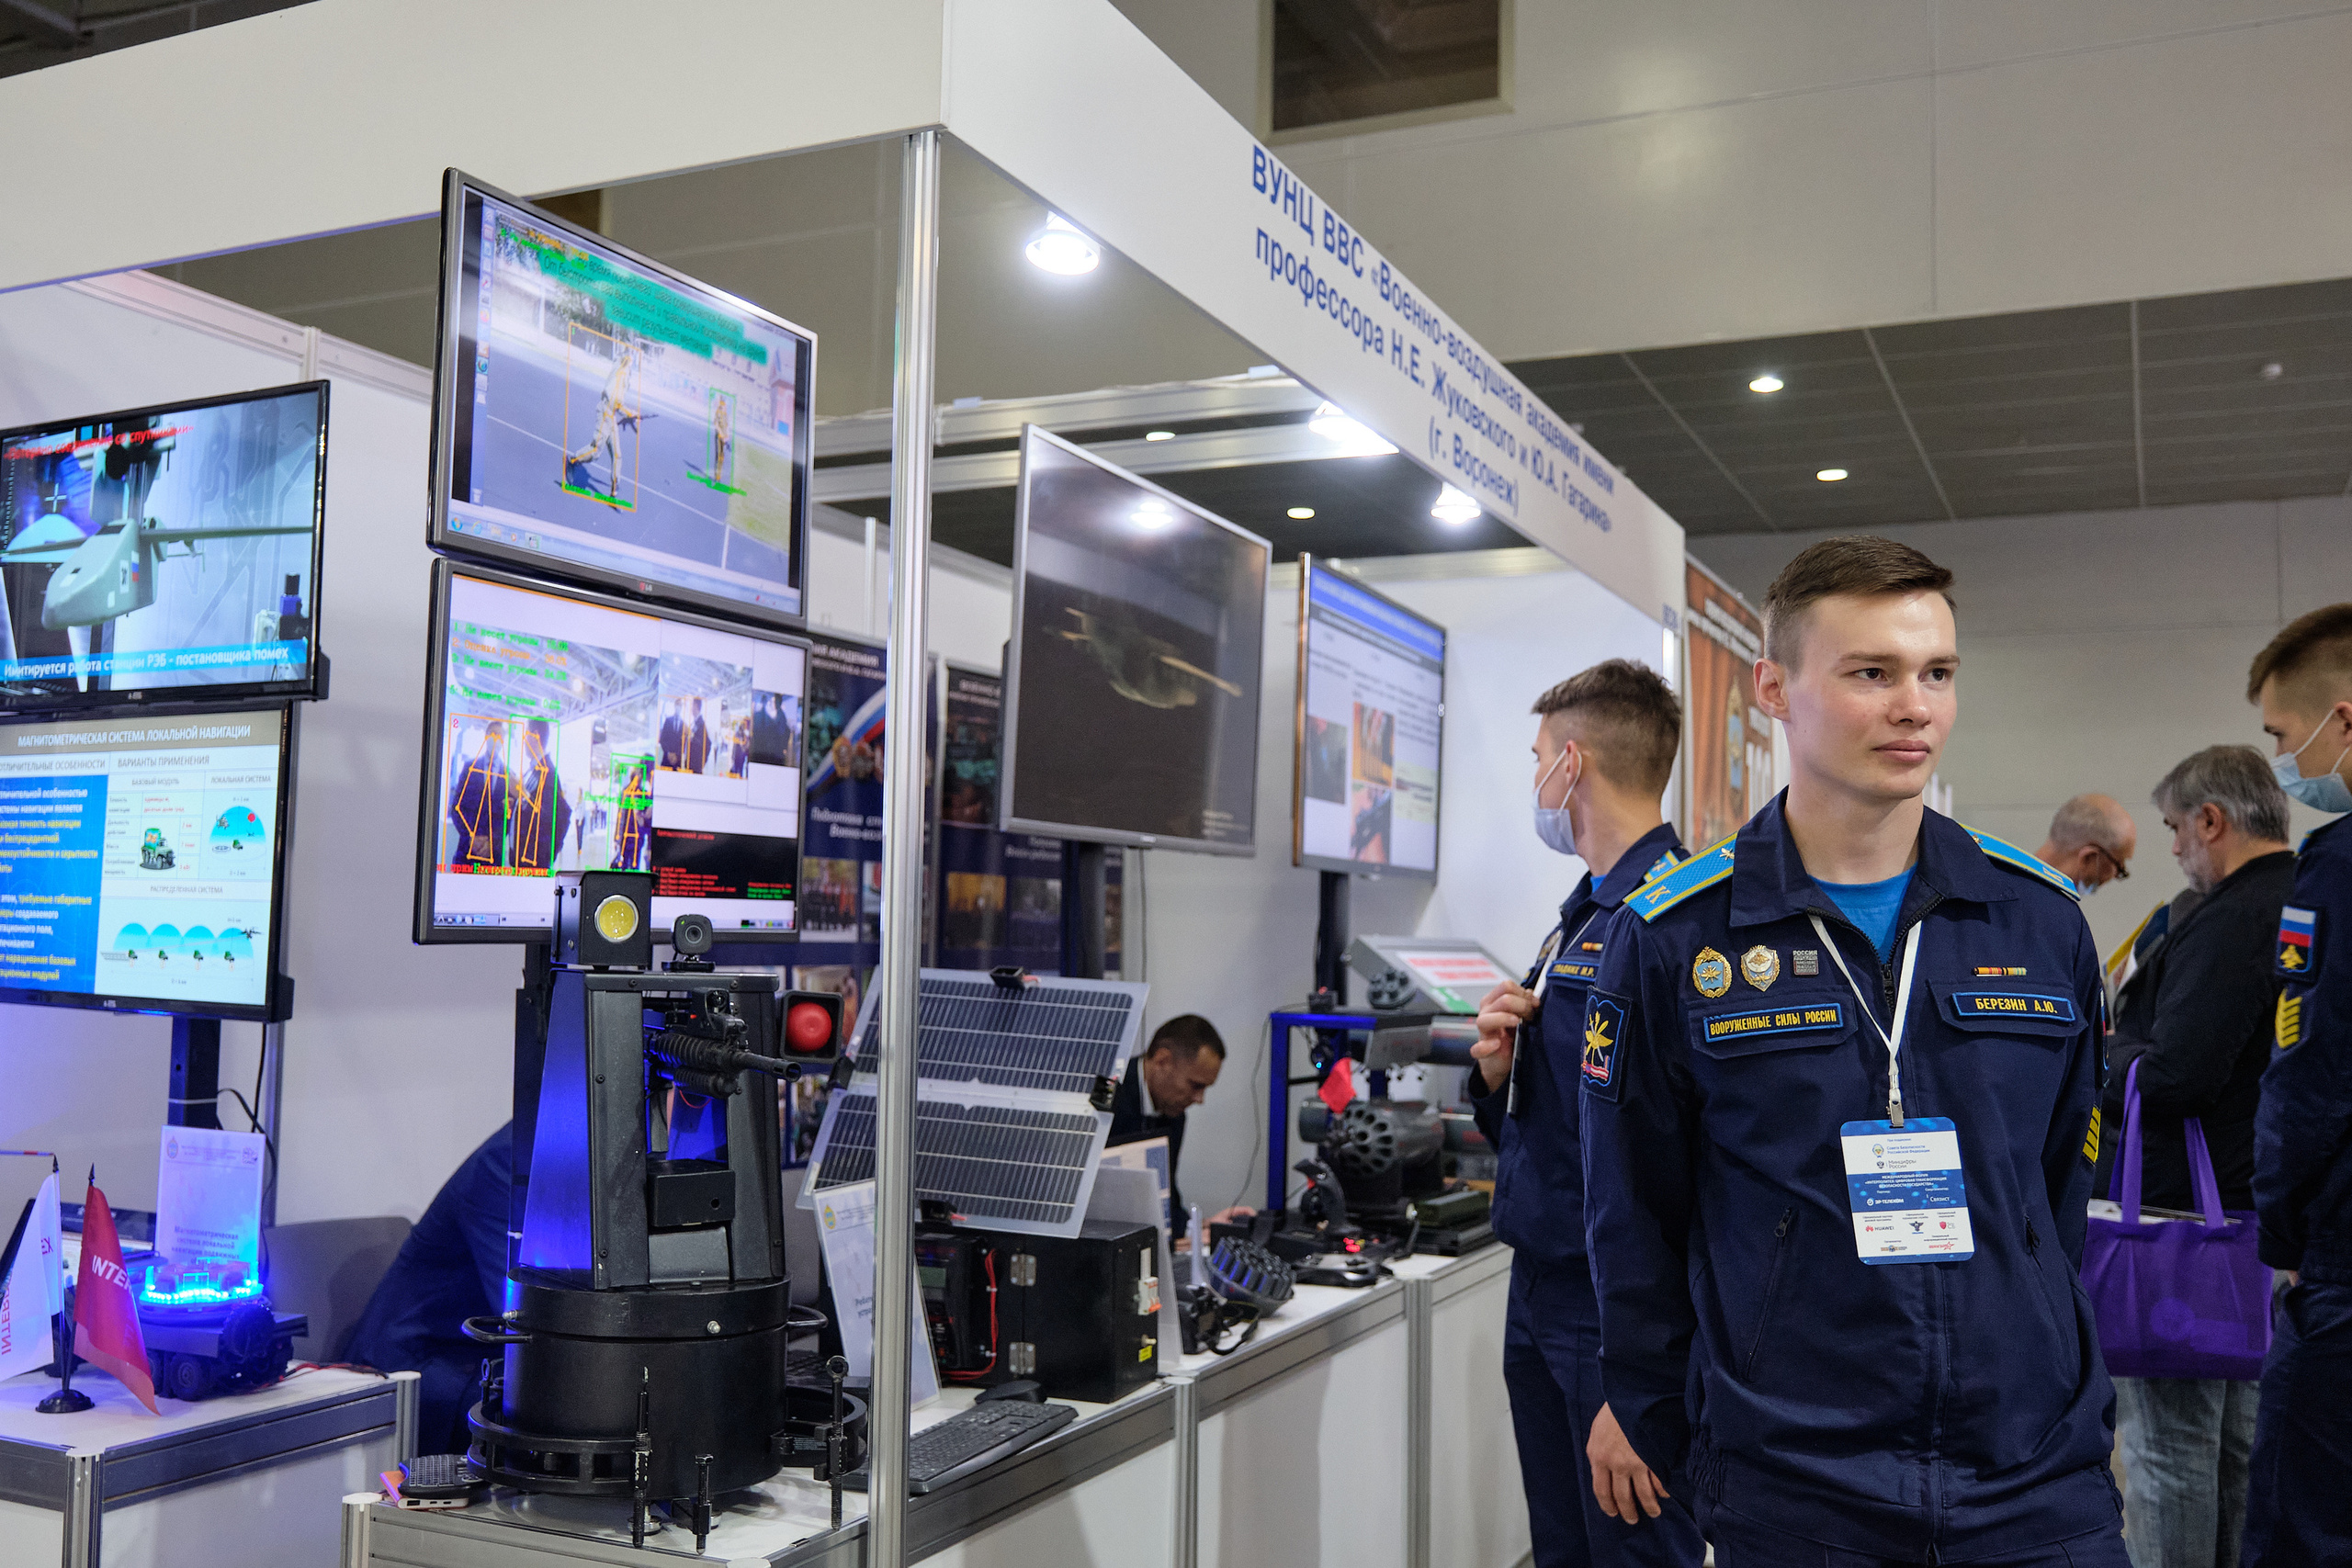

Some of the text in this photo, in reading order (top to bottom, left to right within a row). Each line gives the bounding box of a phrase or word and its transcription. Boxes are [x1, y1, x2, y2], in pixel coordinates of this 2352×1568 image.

[1253, 144, 1314, 246] ВУНЦ
[1324, 209, 1363, 278] ВВС
[1526, 402, 1581, 468] академии
[1582, 451, 1615, 496] имени
[1257, 227, 1385, 356] профессора
[1391, 328, 1425, 389] Н.Е.
[1431, 361, 1517, 459] Жуковского
[1519, 442, 1529, 470] и
[1429, 415, 1520, 517] (г. Воронеж)
[464, 638, 497, 654] Оценка
[4, 661, 66, 679] Имитируется
[67, 657, 102, 677] работа
[104, 655, 145, 673] станции
[147, 652, 167, 668] РЭБ
[175, 651, 253, 668] постановщика
[254, 647, 288, 661] помех
[462, 685, 474, 698] Не
[17, 724, 251, 747] МАГНИТОМЕТРИЧЕСКАЯ СИСТЕМА ЛОКАЛЬНОЙ НАВИГАЦИИ
[55, 759, 106, 771] ОСОБЕННОСТИ
[118, 755, 209, 768] ВАРИАНТЫ ПРИМЕНЕНИЯ
[244, 774, 273, 785] СИСТЕМА
[198, 886, 223, 895] СИСТЕМА
[1974, 998, 2058, 1014] БЕРЕЗИН А.Ю.
[1710, 1009, 1837, 1035] ВООРУЖЕННЫЕ СИЛЫ РОССИИ
[175, 1225, 239, 1240] Магнитометрическая
[201, 1238, 235, 1249] локальной
[203, 1248, 240, 1260] подвижных
